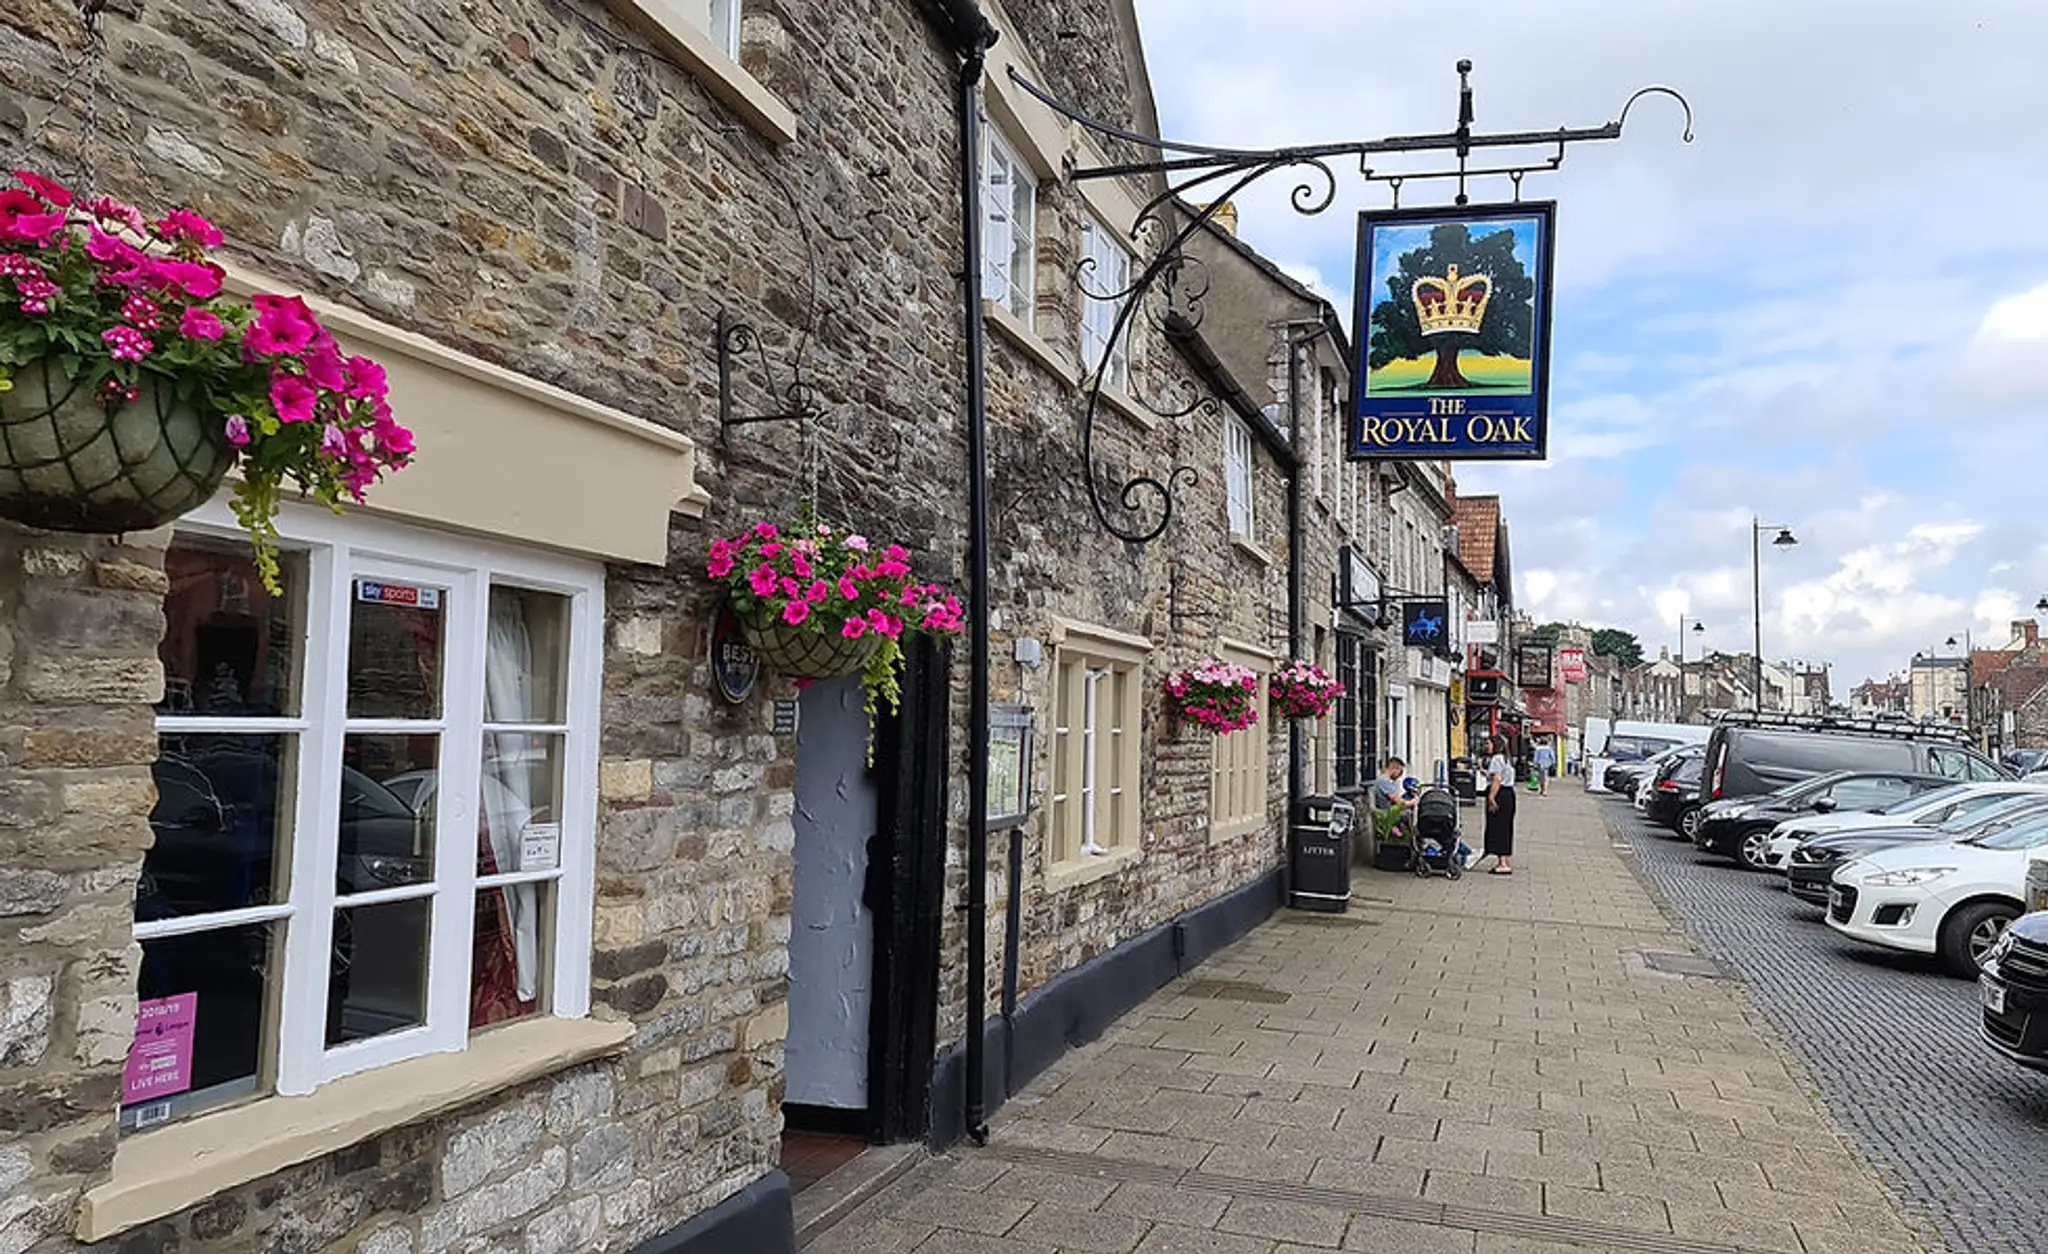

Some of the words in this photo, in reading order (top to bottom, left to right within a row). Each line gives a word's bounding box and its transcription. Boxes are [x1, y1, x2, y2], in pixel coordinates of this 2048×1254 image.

[1428, 398, 1466, 415] THE
[1361, 416, 1457, 446] ROYAL
[1467, 415, 1534, 443] OAK
[365, 584, 381, 601] sky
[384, 586, 416, 602] sports
[1303, 845, 1336, 857] LITTER
[131, 1076, 153, 1091] LIVE
[154, 1071, 180, 1084] HERE
